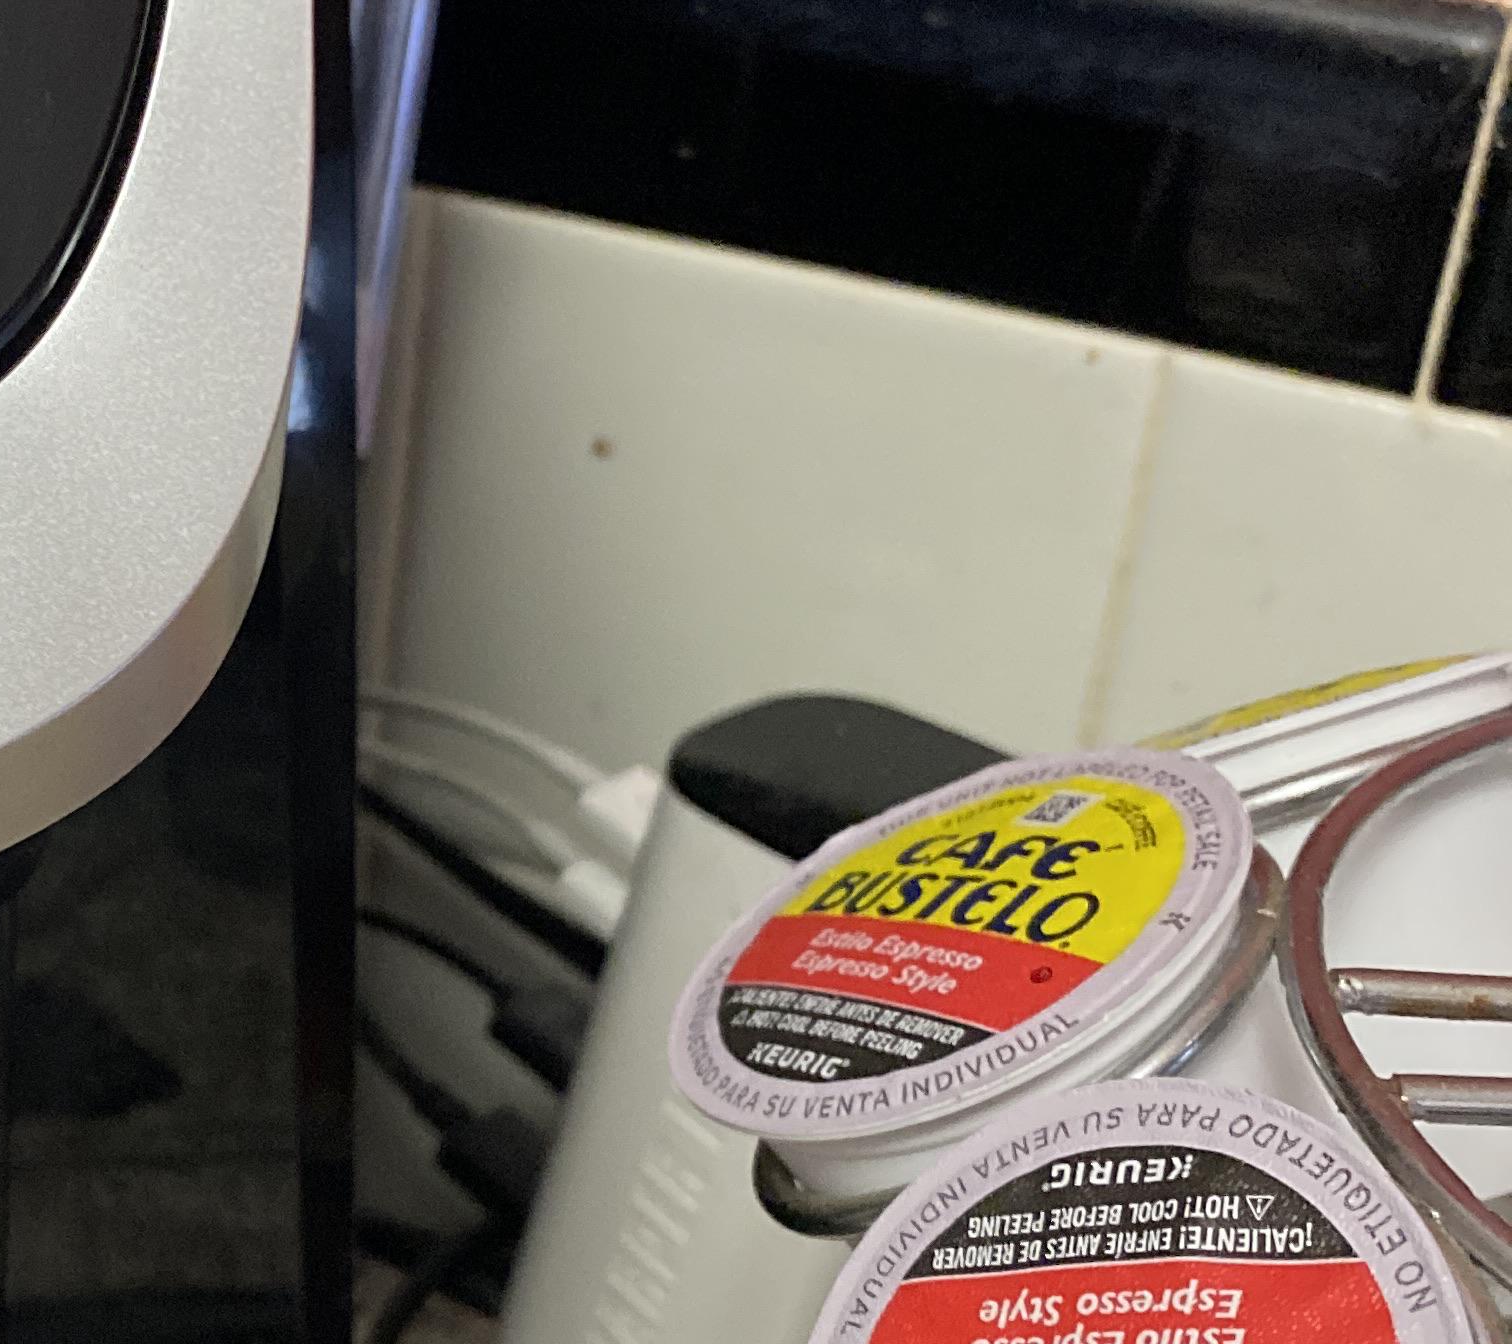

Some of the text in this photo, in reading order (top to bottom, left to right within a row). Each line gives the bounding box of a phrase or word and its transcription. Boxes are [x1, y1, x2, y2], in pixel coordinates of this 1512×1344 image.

[809, 927, 984, 972] Estilo Espresso
[791, 950, 957, 995] Espresso Style
[763, 1094, 798, 1118] SU
[804, 1090, 889, 1118] VENTA
[902, 1012, 1080, 1103] INDIVIDUAL
[1043, 1155, 1192, 1191] KEURIG
[841, 1103, 1437, 1336] NO ETIQUETADO PARA SU VENTA INDIVIDUAL
[969, 1196, 1239, 1239] HOT! COOL BEFORE PEELING
[934, 1245, 1006, 1269] REMOVER
[1013, 1241, 1038, 1263] DE
[1047, 1236, 1097, 1260] ANTES
[979, 1289, 1242, 1326] Espresso Style
